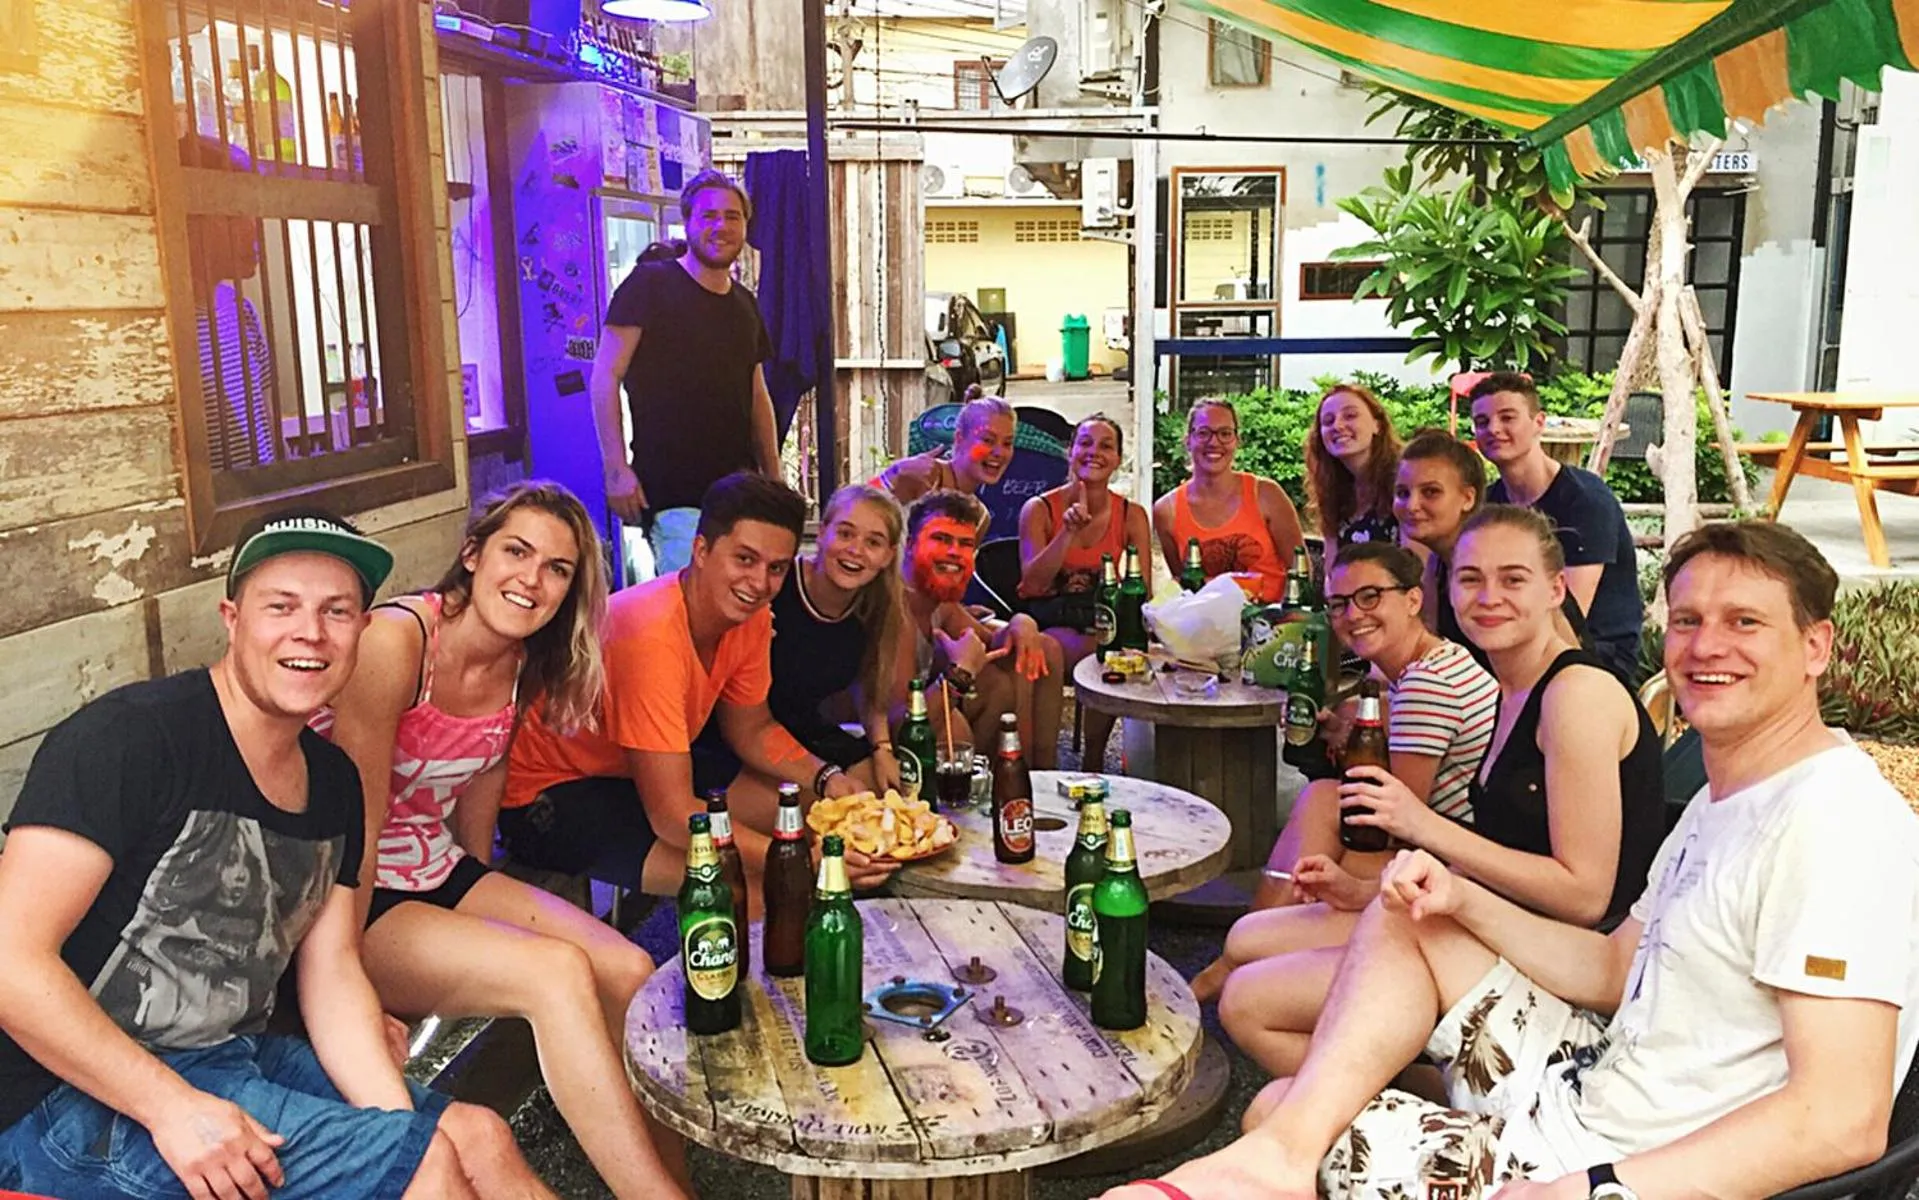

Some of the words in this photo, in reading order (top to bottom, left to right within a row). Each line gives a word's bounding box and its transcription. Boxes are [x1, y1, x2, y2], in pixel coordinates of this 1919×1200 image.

[264, 517, 349, 535] HUISDI
[1004, 816, 1033, 834] LEO
[690, 948, 738, 967] Chang
